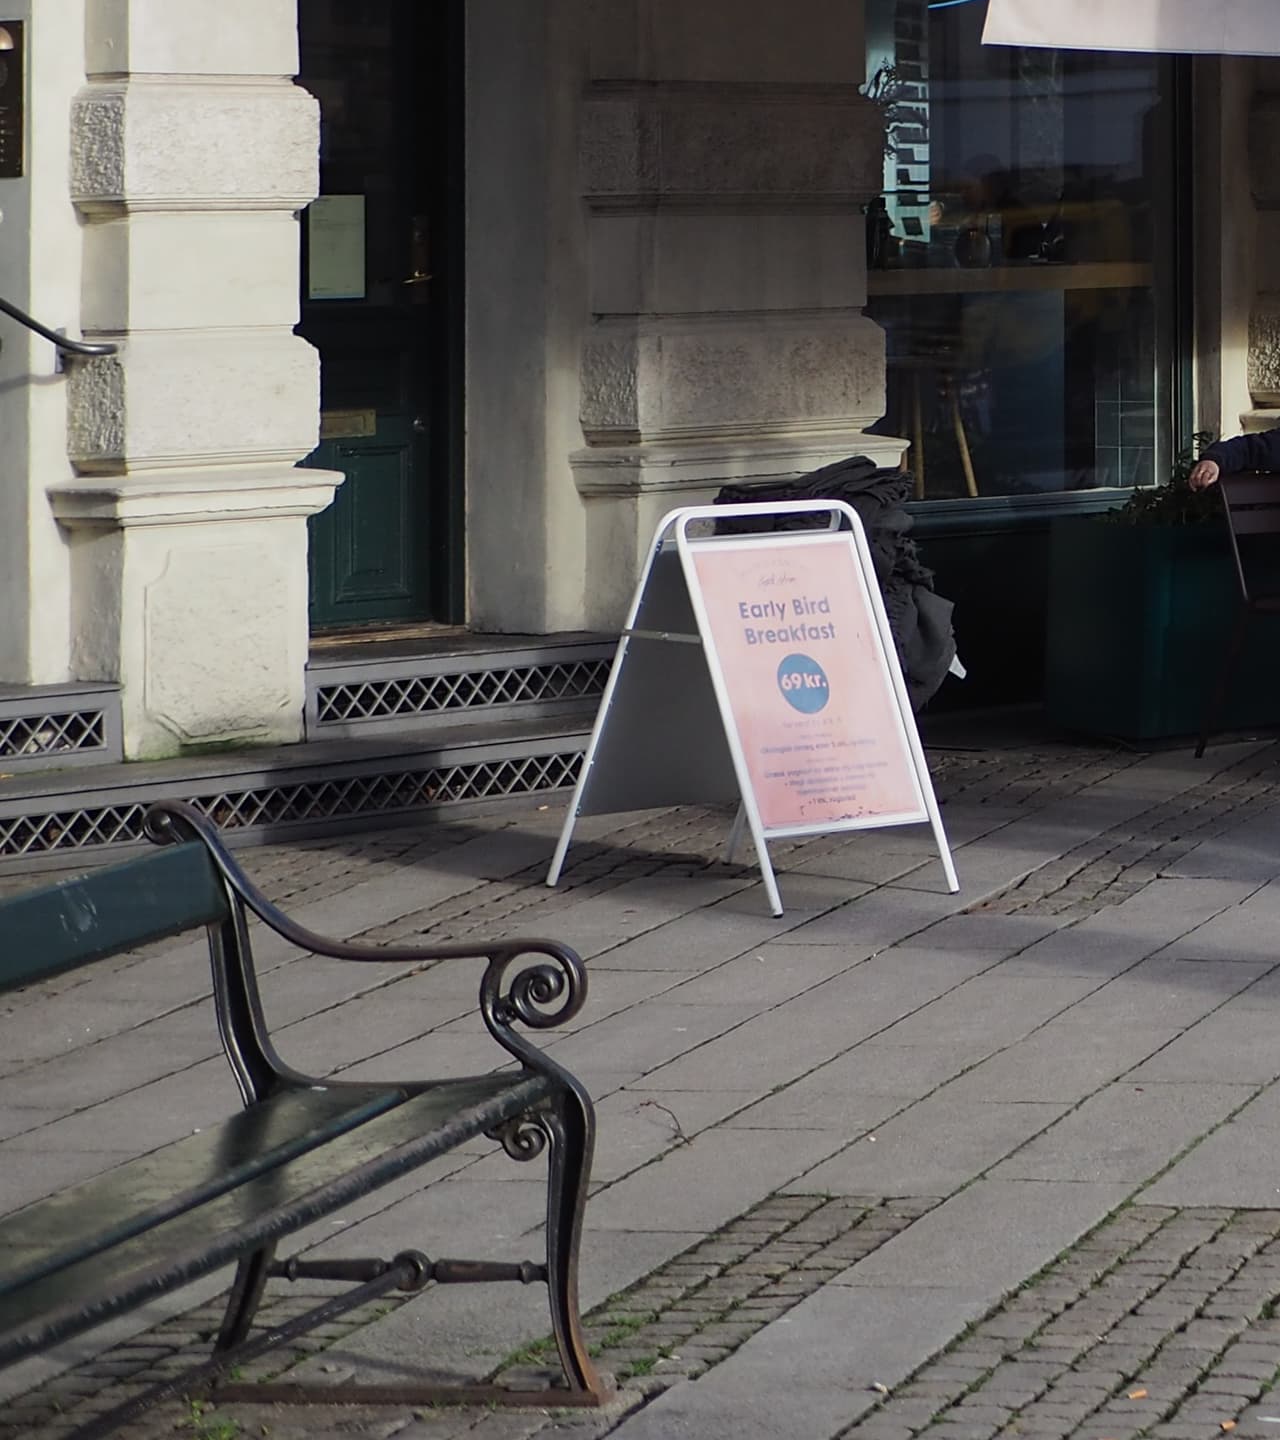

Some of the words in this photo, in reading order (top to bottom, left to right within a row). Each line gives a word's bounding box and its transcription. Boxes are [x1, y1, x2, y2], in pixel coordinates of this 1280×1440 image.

[738, 600, 786, 622] Early
[792, 595, 831, 615] Bird
[744, 622, 836, 645] Breakfast
[781, 672, 802, 691] 69
